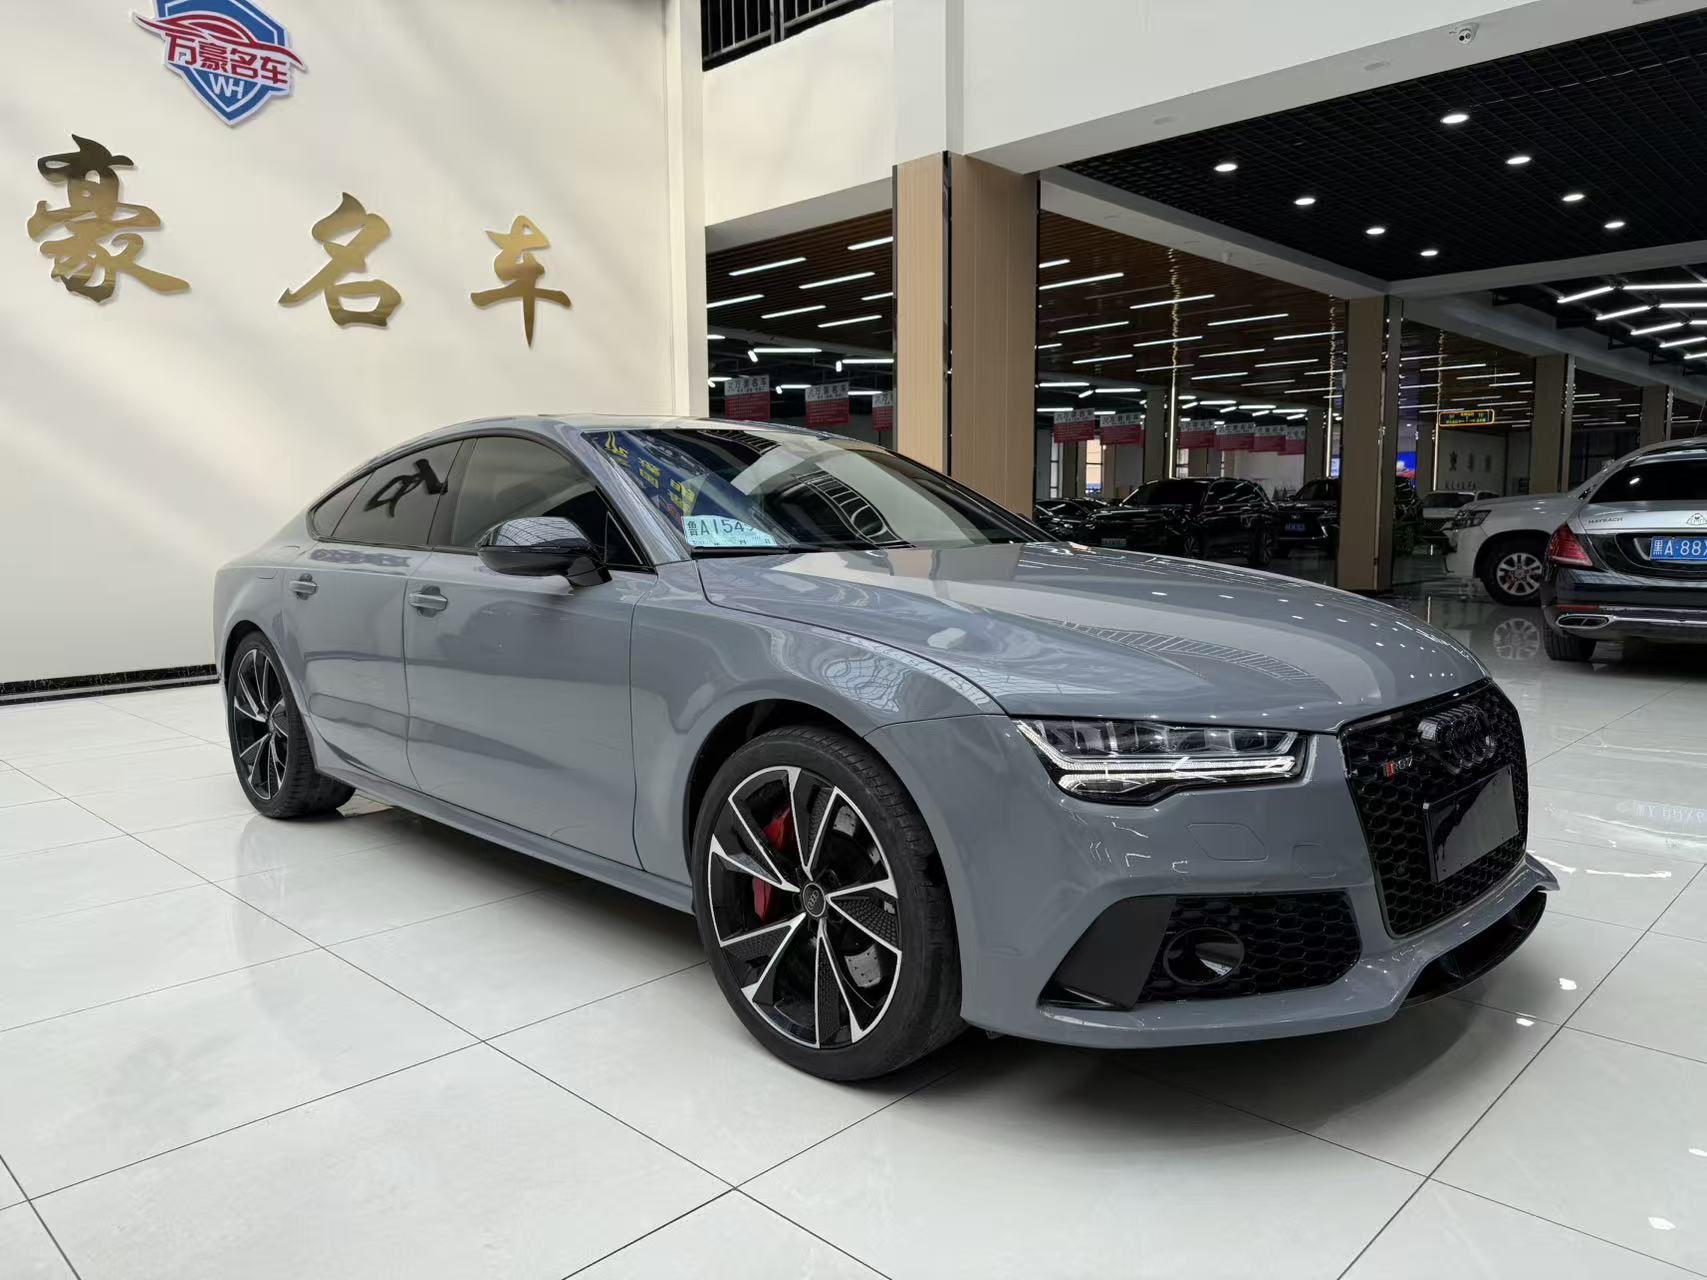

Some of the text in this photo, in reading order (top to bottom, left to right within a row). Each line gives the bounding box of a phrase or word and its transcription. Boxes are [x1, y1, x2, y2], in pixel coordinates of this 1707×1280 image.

[165, 33, 288, 84] 万豪名车
[208, 73, 245, 99] WH
